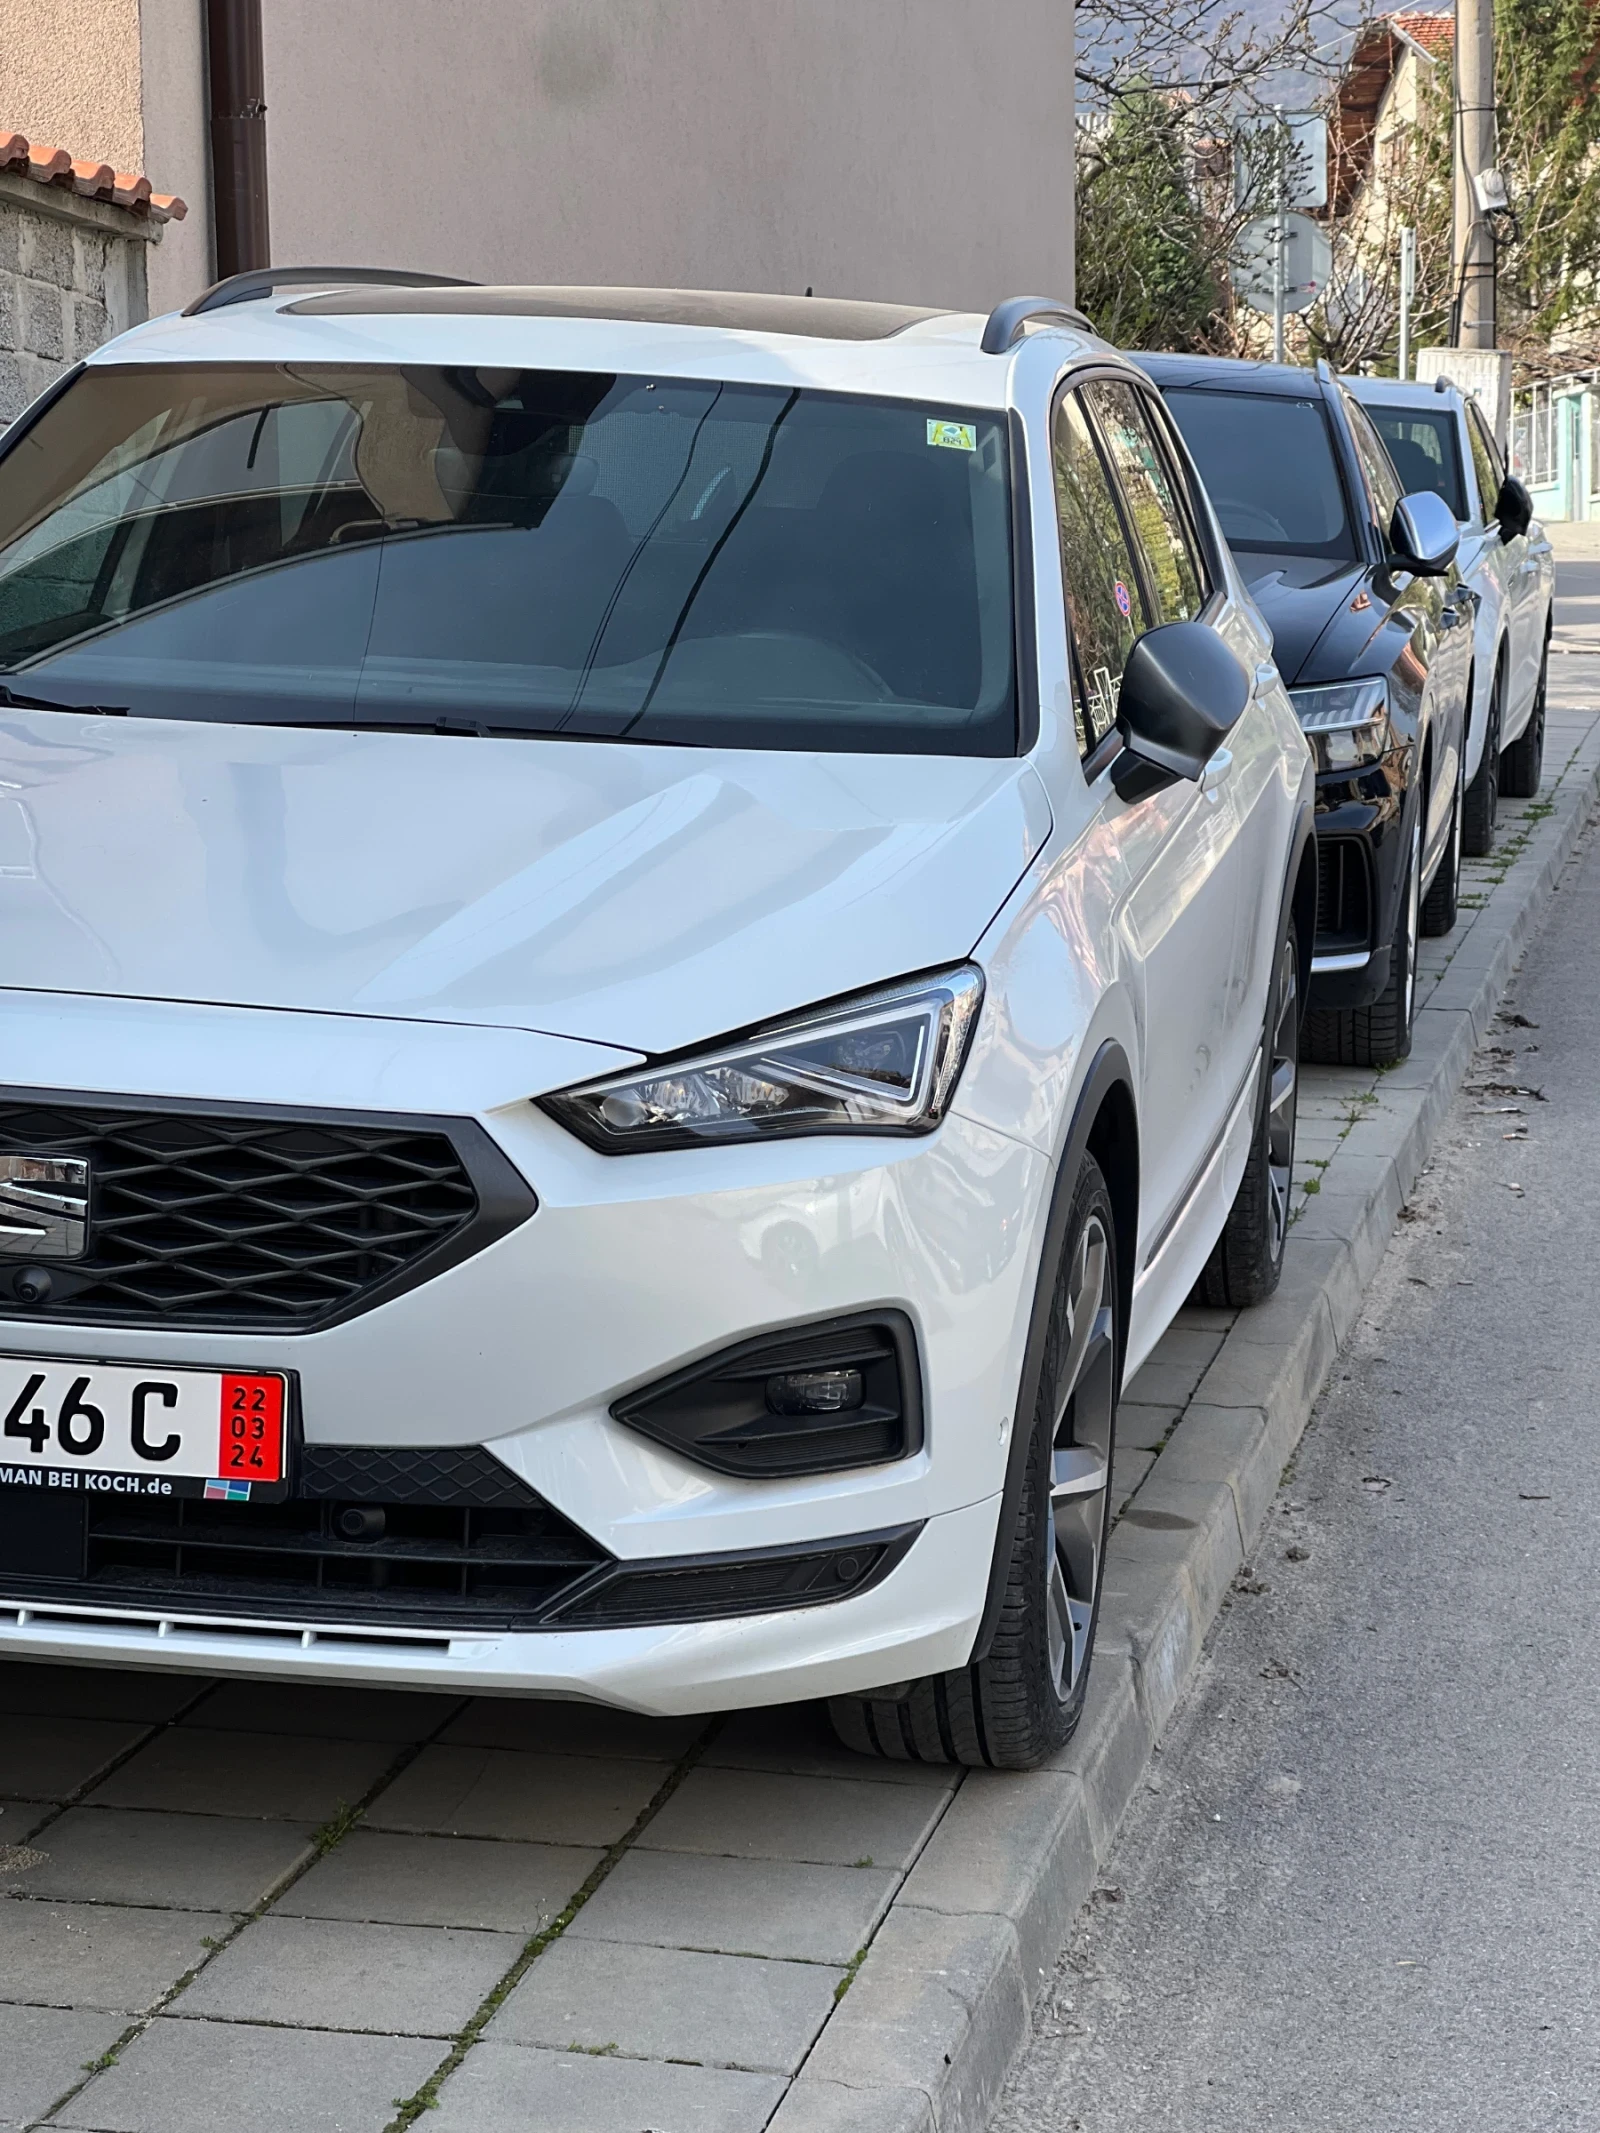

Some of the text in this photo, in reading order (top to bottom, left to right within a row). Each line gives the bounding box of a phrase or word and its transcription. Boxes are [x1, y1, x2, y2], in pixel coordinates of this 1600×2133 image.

[231, 1387, 266, 1412] 22
[4, 1373, 182, 1461] 46 C
[231, 1415, 265, 1440] 03
[230, 1444, 264, 1467] 24
[48, 1471, 79, 1488] BEI
[85, 1474, 173, 1495] KOCH.de
